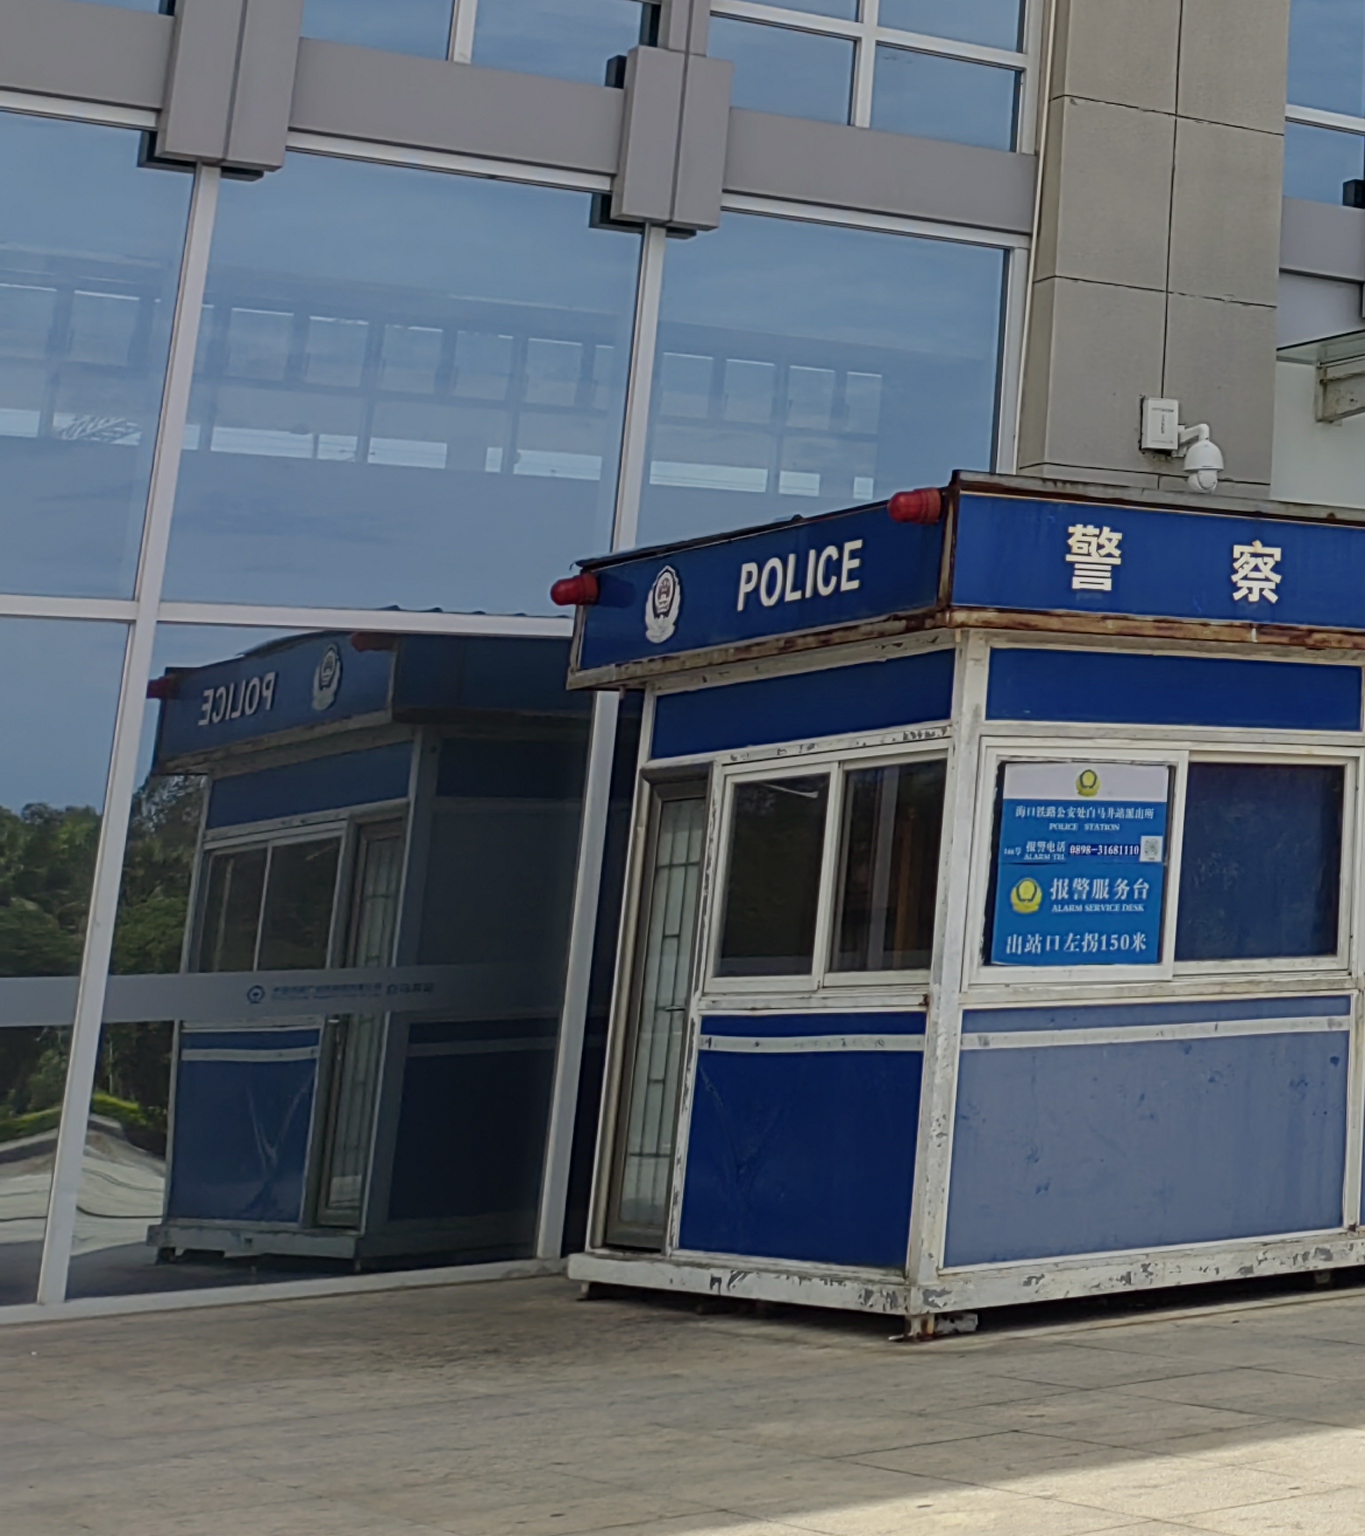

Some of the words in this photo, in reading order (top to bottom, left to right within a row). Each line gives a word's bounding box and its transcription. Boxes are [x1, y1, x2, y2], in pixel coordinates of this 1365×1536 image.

[736, 539, 864, 612] POLICE
[1049, 823, 1078, 831] POLICE
[1084, 823, 1120, 831] STATION
[1026, 841, 1066, 853] 报警电话
[1069, 844, 1140, 855] 0898-31681110
[1050, 877, 1150, 901] 报警服务台
[1051, 904, 1083, 912] ALARM
[1084, 903, 1120, 912] SERVICE
[1122, 903, 1145, 912] DESK
[1006, 932, 1147, 955] 出站口左拐150米
